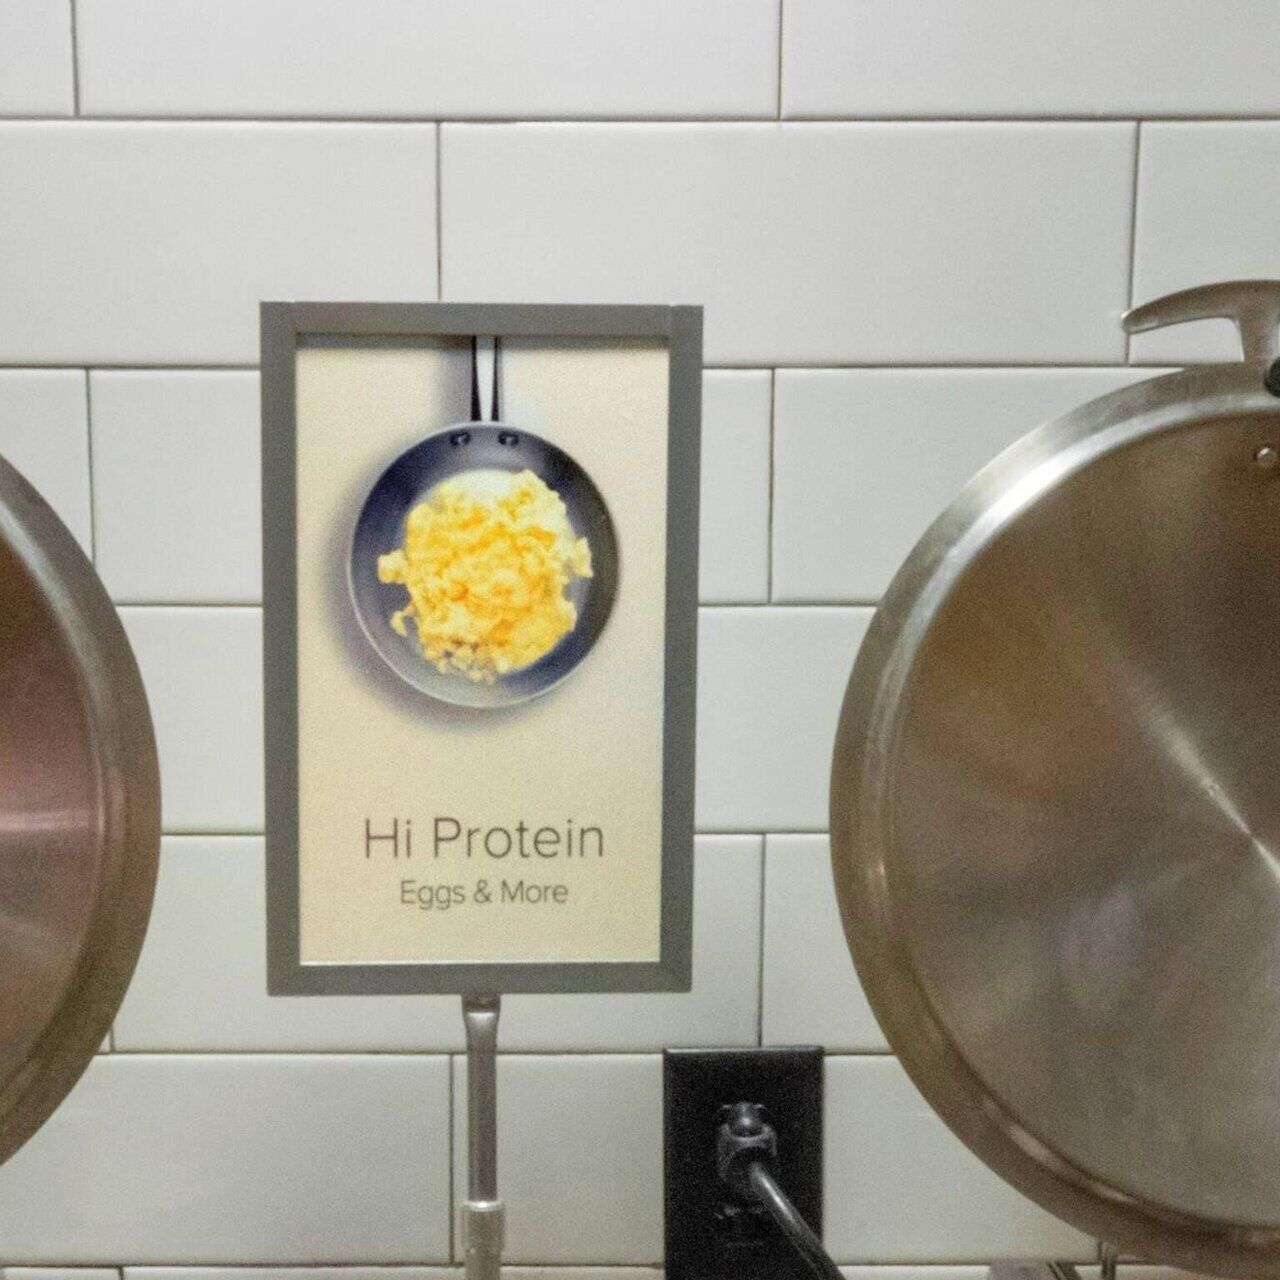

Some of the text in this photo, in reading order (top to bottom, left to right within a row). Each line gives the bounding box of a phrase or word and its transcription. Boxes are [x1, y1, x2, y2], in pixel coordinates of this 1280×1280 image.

[365, 817, 604, 859] Hi Protein
[400, 879, 569, 910] Eggs & More
